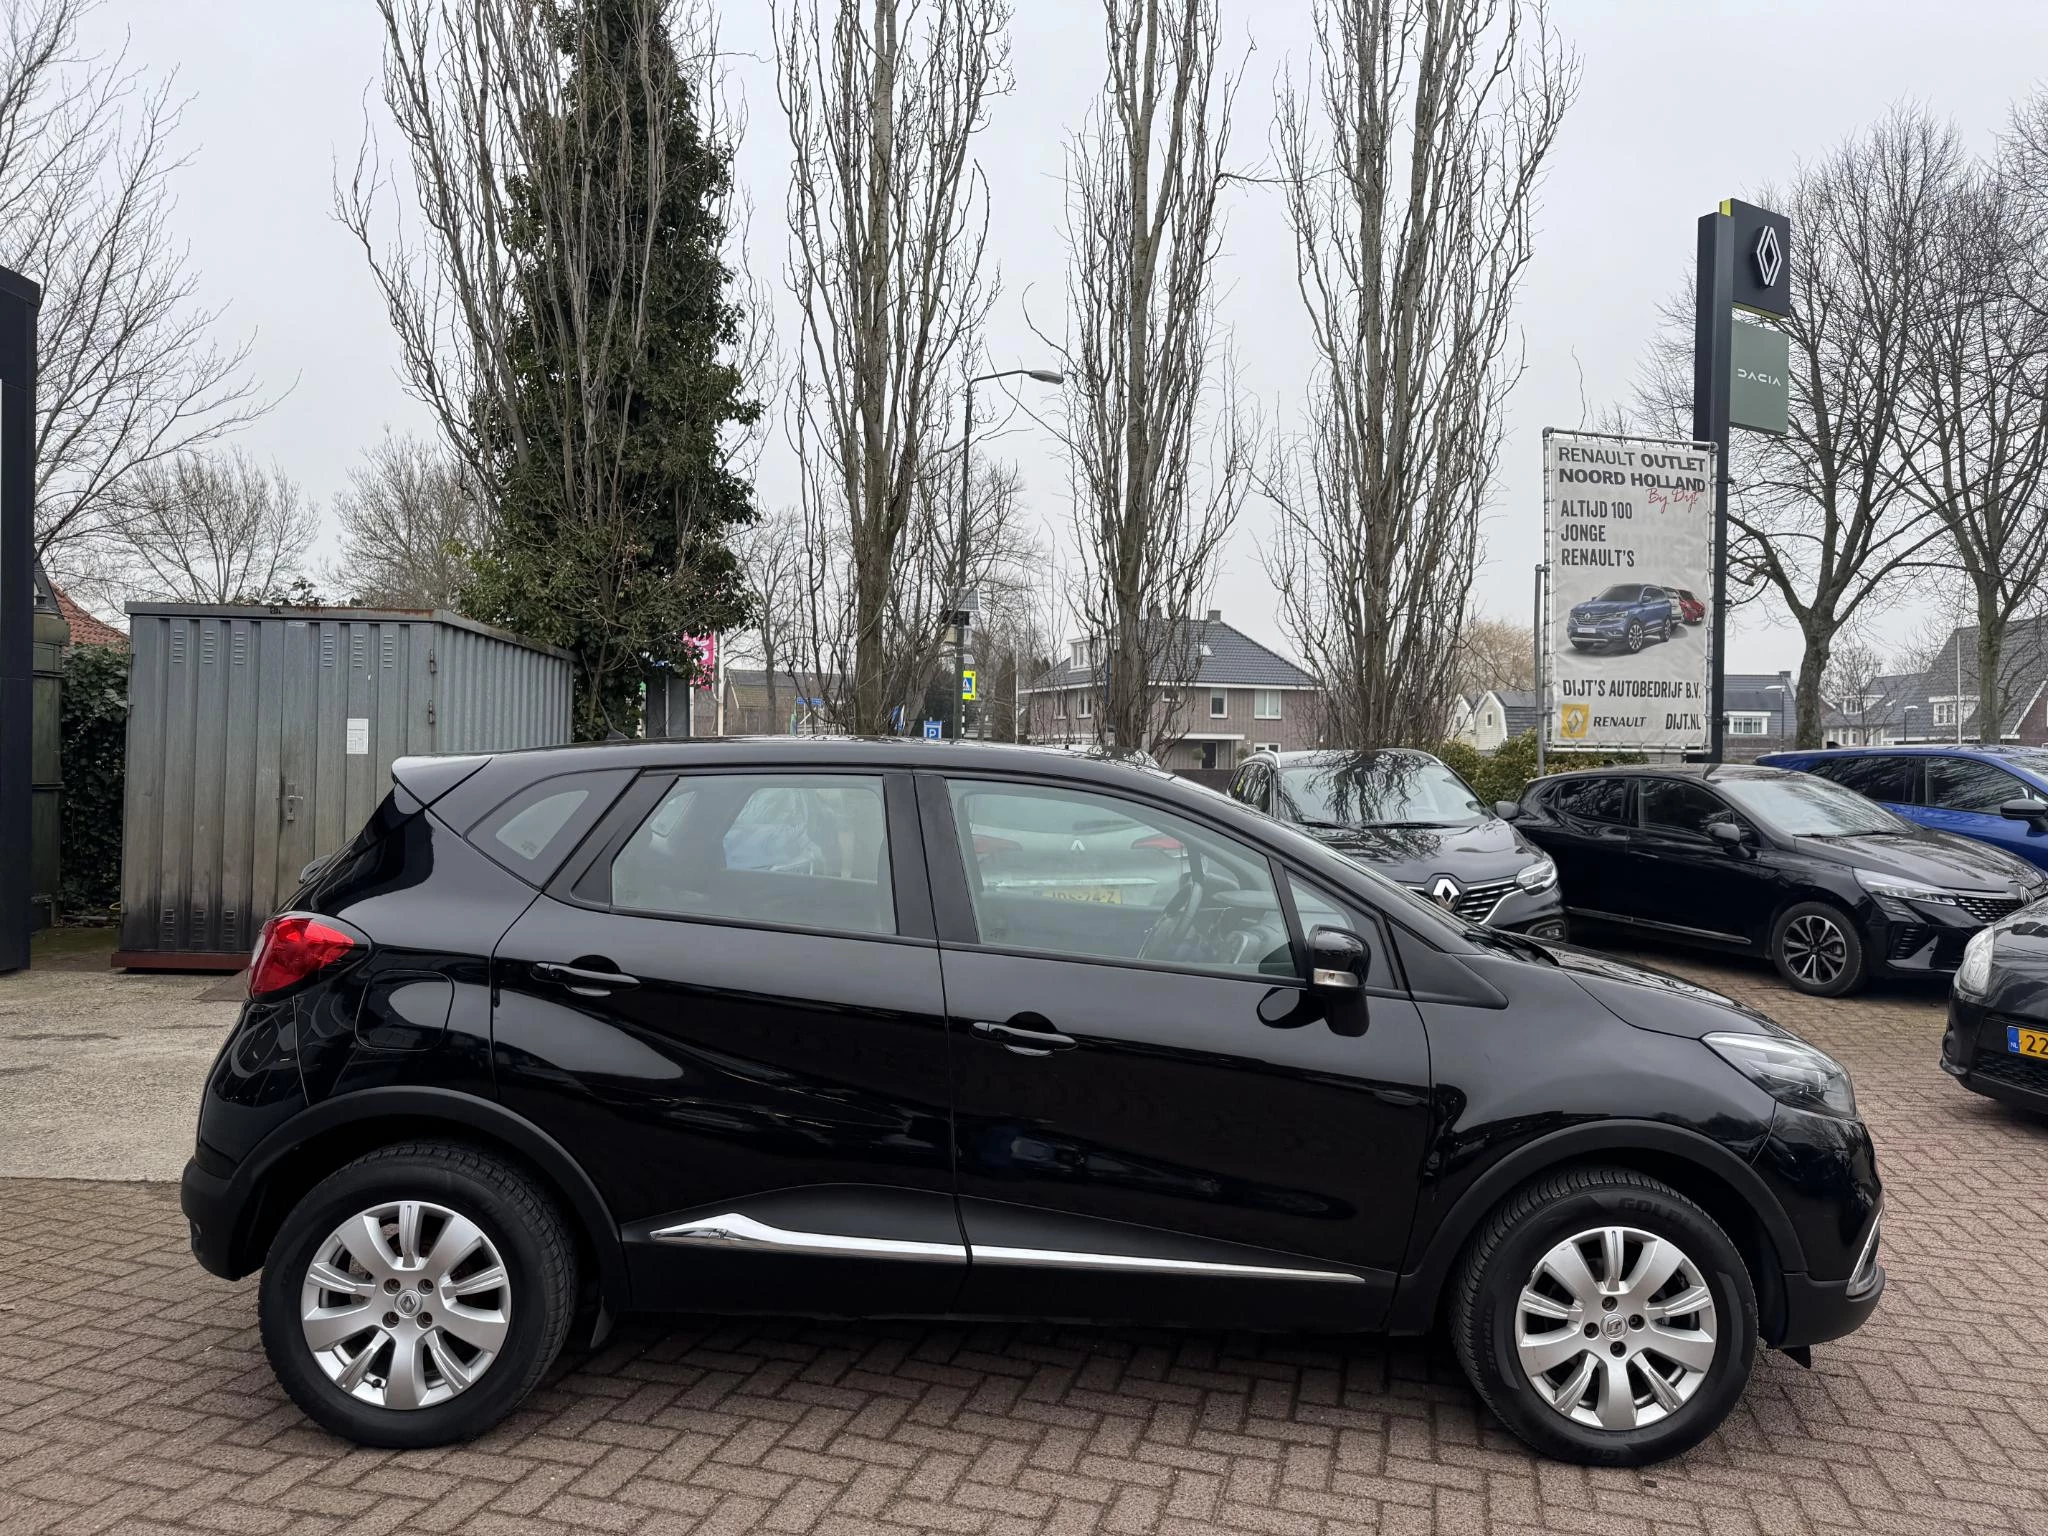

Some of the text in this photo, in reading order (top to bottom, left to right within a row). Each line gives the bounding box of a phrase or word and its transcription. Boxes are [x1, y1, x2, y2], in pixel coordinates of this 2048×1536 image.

[1737, 368, 1781, 386] DACIA
[1558, 446, 1705, 473] RENAULT OUTLET
[1559, 468, 1706, 493] NOORD HOLLAND
[1561, 499, 1633, 519] ALTIJD 100
[1646, 488, 1668, 514] By
[1561, 524, 1606, 542] JONGE
[1561, 548, 1635, 567] RENAULT'S
[1562, 679, 1701, 699] DIJT'S AUTOBEDRIJF B.V.
[1593, 716, 1647, 727] RENAULT
[1665, 713, 1702, 730] DIJT.NL
[929, 729, 937, 738] P
[2010, 1041, 2019, 1049] NL
